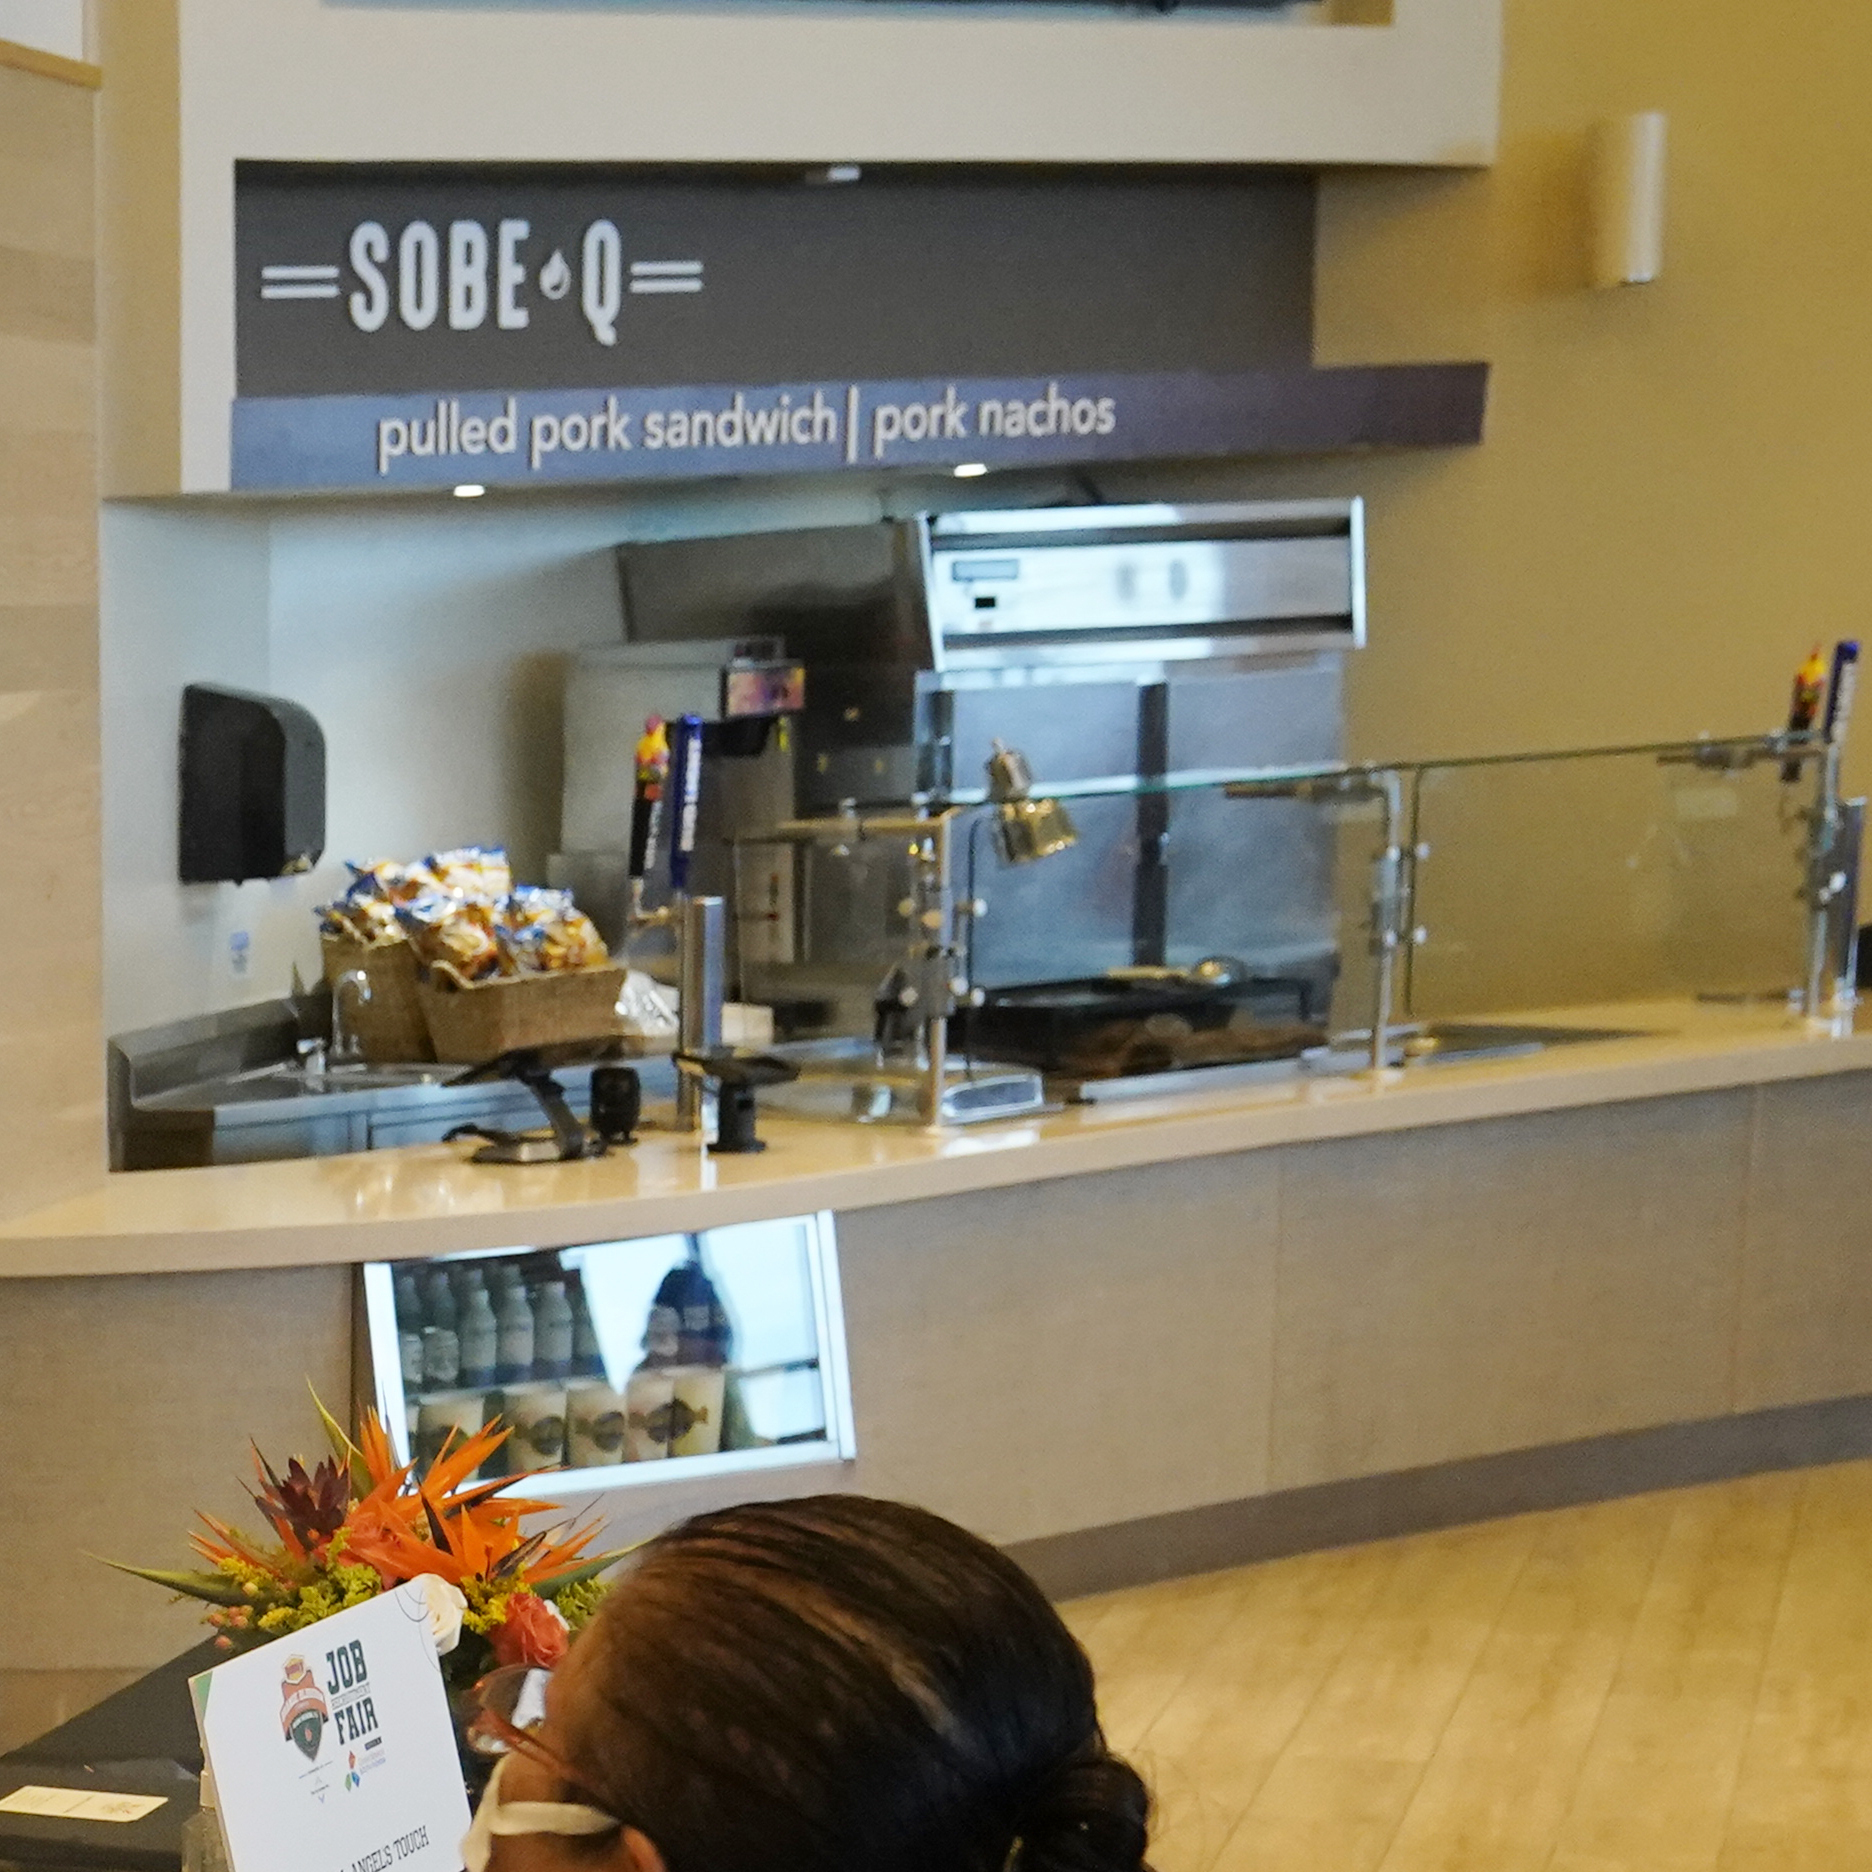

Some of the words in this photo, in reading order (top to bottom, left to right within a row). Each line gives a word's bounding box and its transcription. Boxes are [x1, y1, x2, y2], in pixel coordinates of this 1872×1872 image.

[349, 218, 530, 332] SOBE
[582, 219, 622, 346] Q
[378, 397, 517, 476] pulled
[530, 396, 633, 470] pork
[643, 389, 837, 450] sandwich
[873, 384, 969, 460] pork
[979, 381, 1117, 437] nachos
[326, 1639, 368, 1694] JOB
[334, 1697, 378, 1746] FAIR
[394, 1825, 430, 1860] TOUCH
